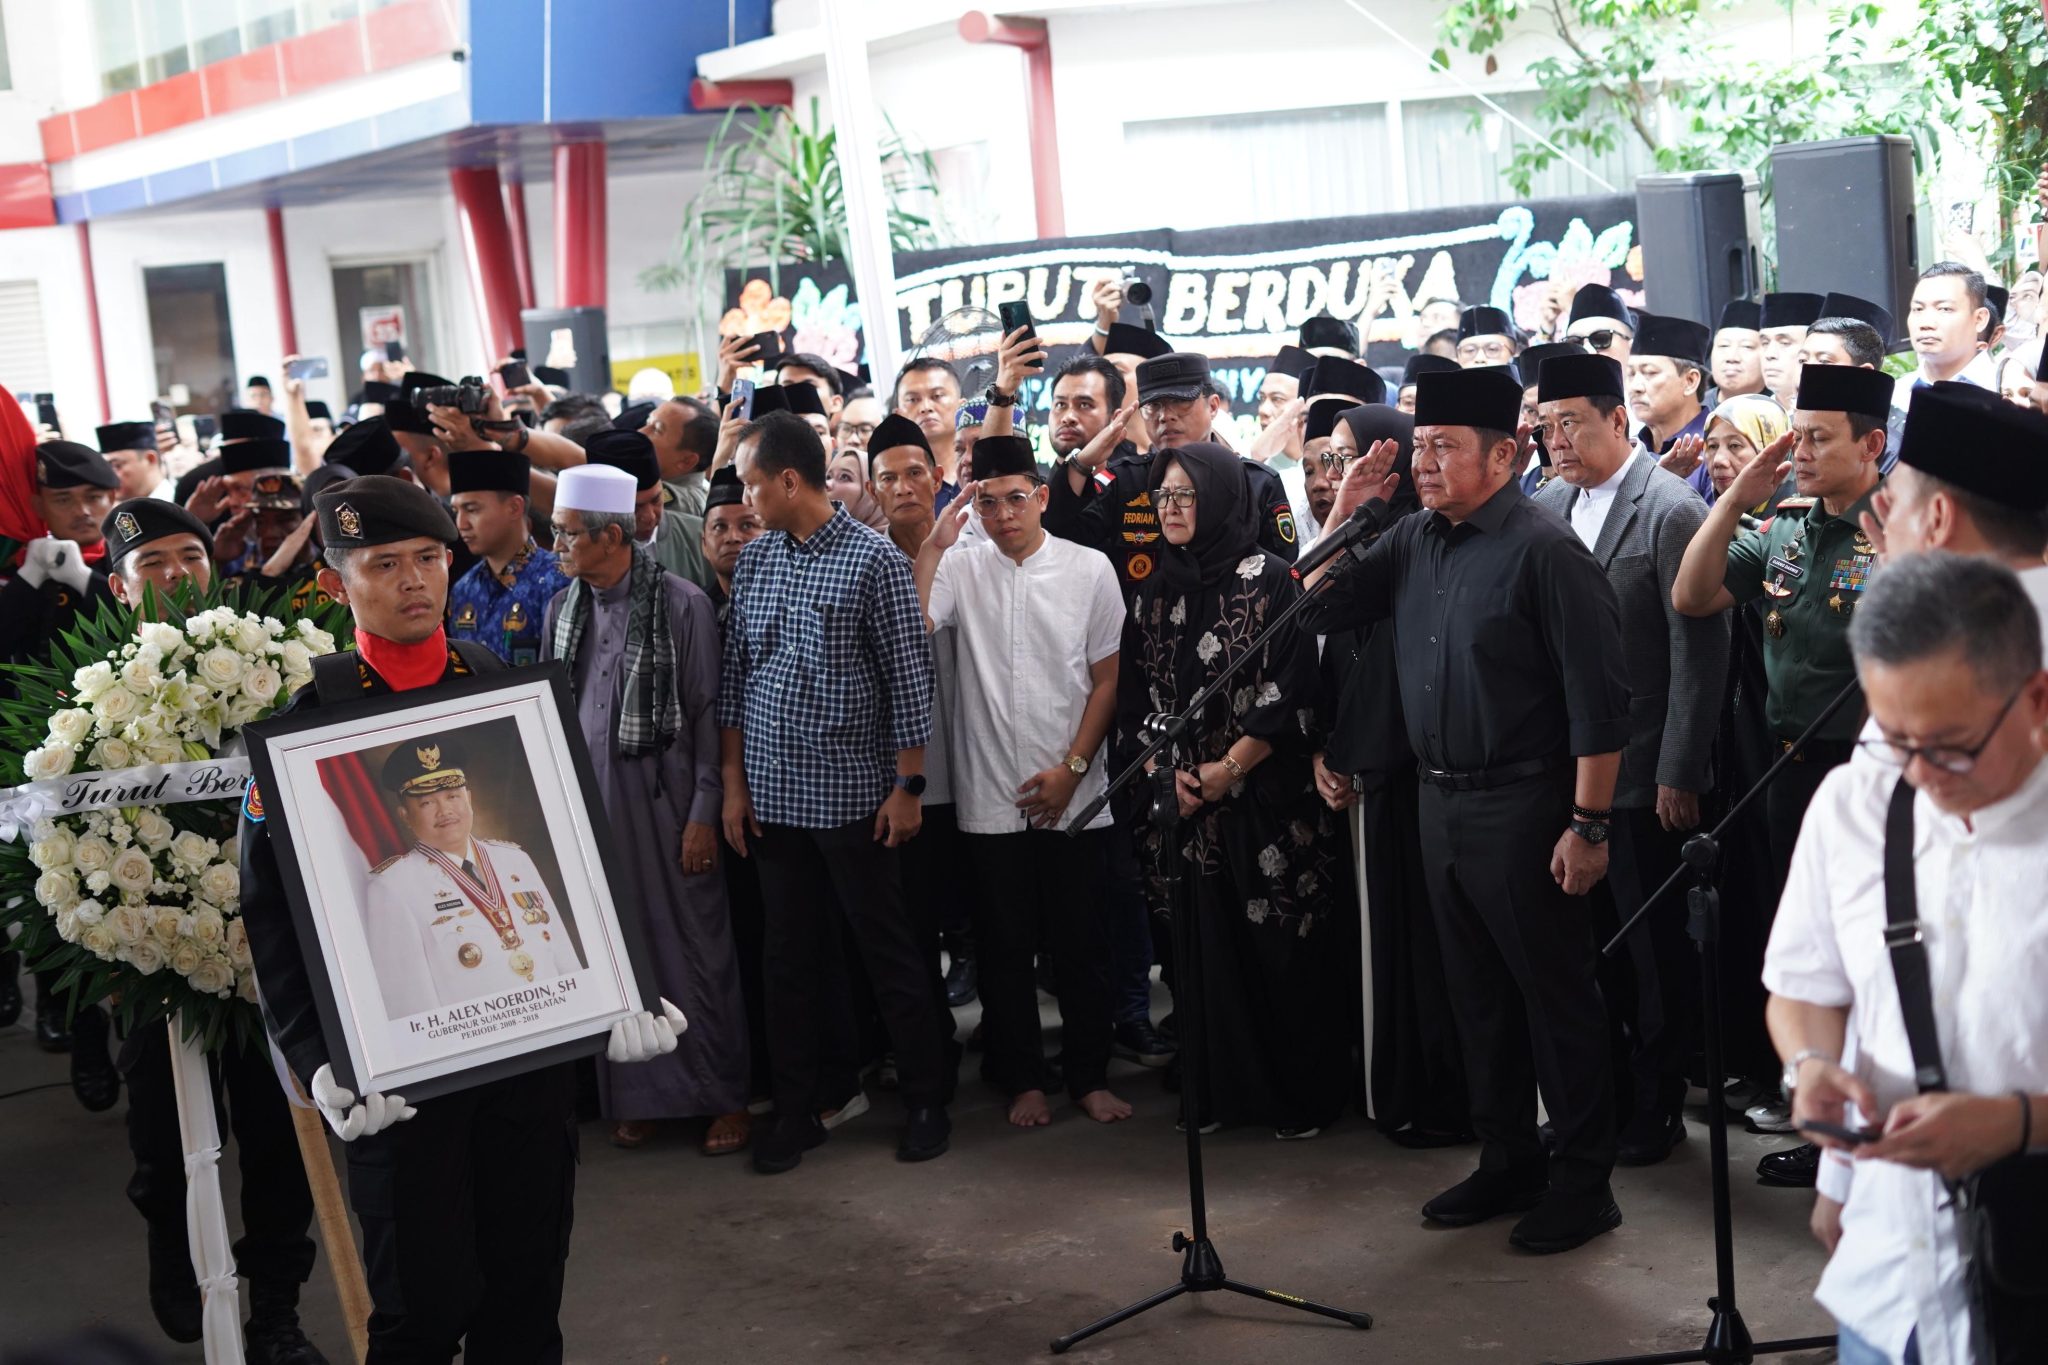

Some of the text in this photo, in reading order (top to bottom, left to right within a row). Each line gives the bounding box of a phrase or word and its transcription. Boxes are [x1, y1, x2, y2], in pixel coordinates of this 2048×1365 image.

[1123, 512, 1155, 525] FEDRIAN
[61, 772, 172, 809] Turut
[410, 978, 577, 1033] Ir. H. ALEX NOERDIN, SH
[428, 995, 567, 1040] GUBERNUR SUMATERA SELATAN
[461, 1025, 498, 1040] PERIODE
[500, 1019, 517, 1031] 2008
[522, 1013, 540, 1025] 2018
